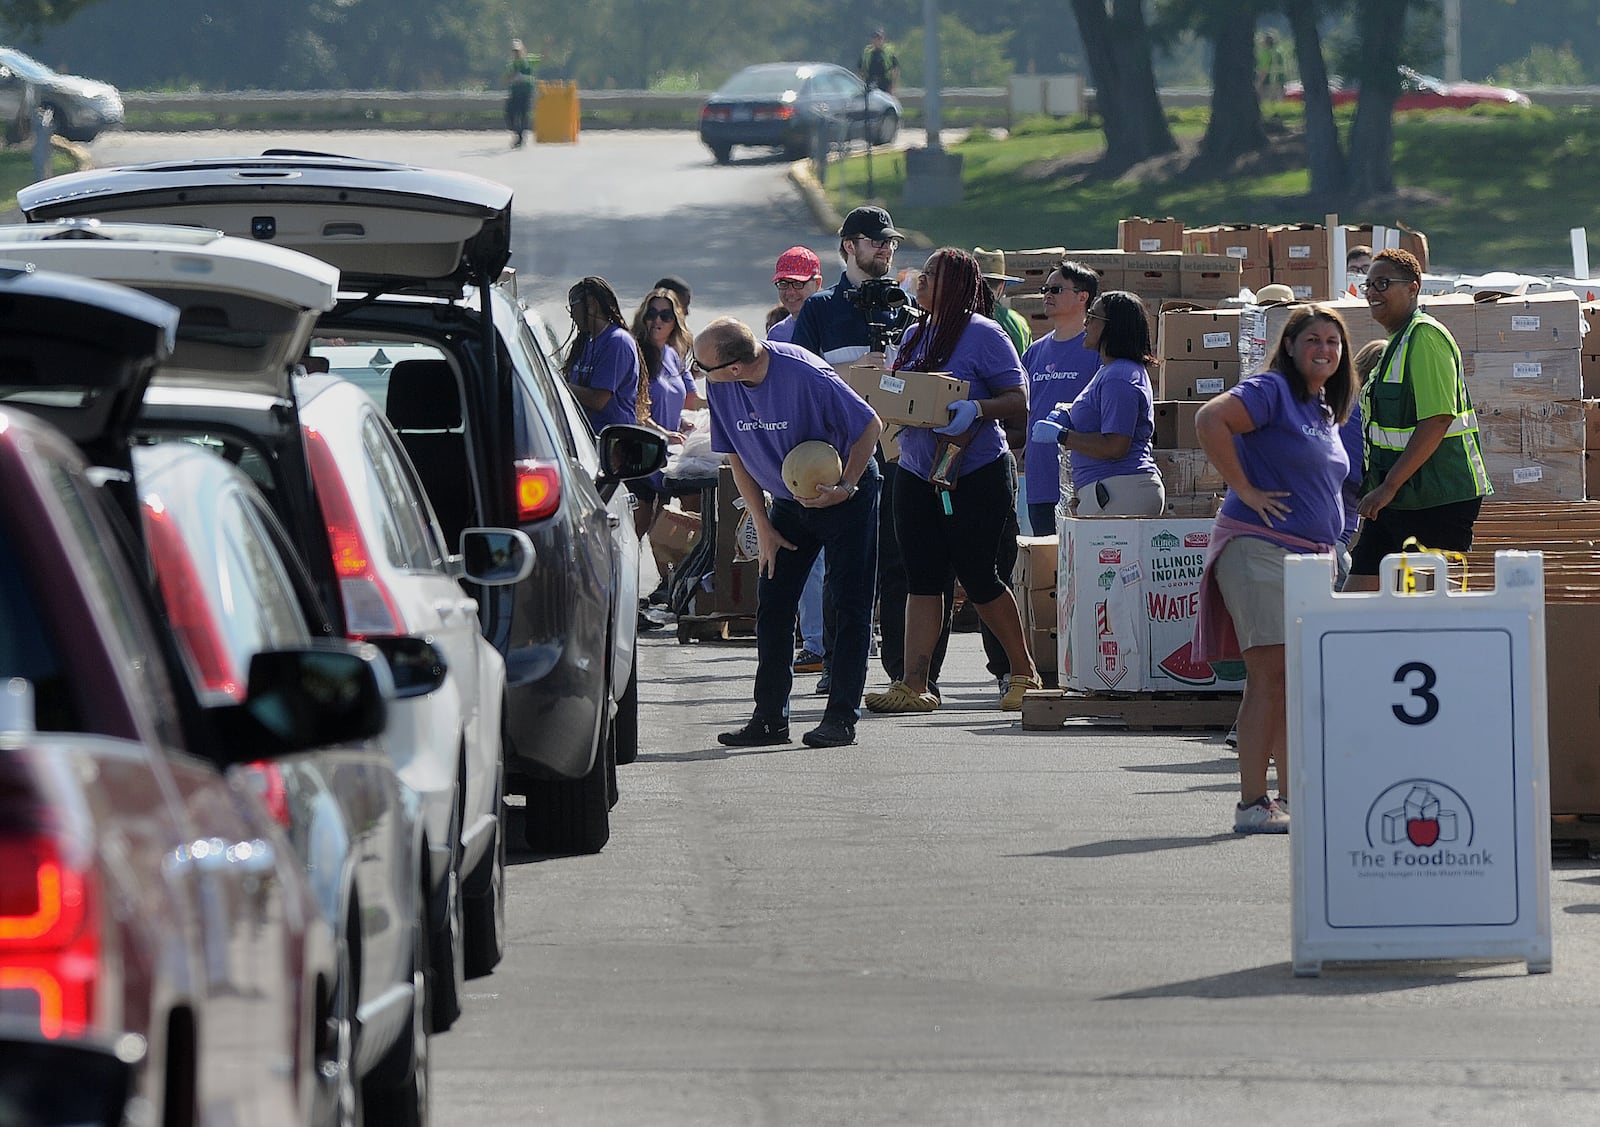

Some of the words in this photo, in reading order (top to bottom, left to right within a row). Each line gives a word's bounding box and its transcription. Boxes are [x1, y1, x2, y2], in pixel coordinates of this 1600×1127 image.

[1151, 554, 1204, 570] ILLINOIS
[1151, 566, 1204, 582] INDIANA
[1147, 591, 1199, 620] WATE
[1392, 662, 1439, 725] 3
[1349, 850, 1386, 867] The
[1393, 849, 1494, 866] Foodbank
